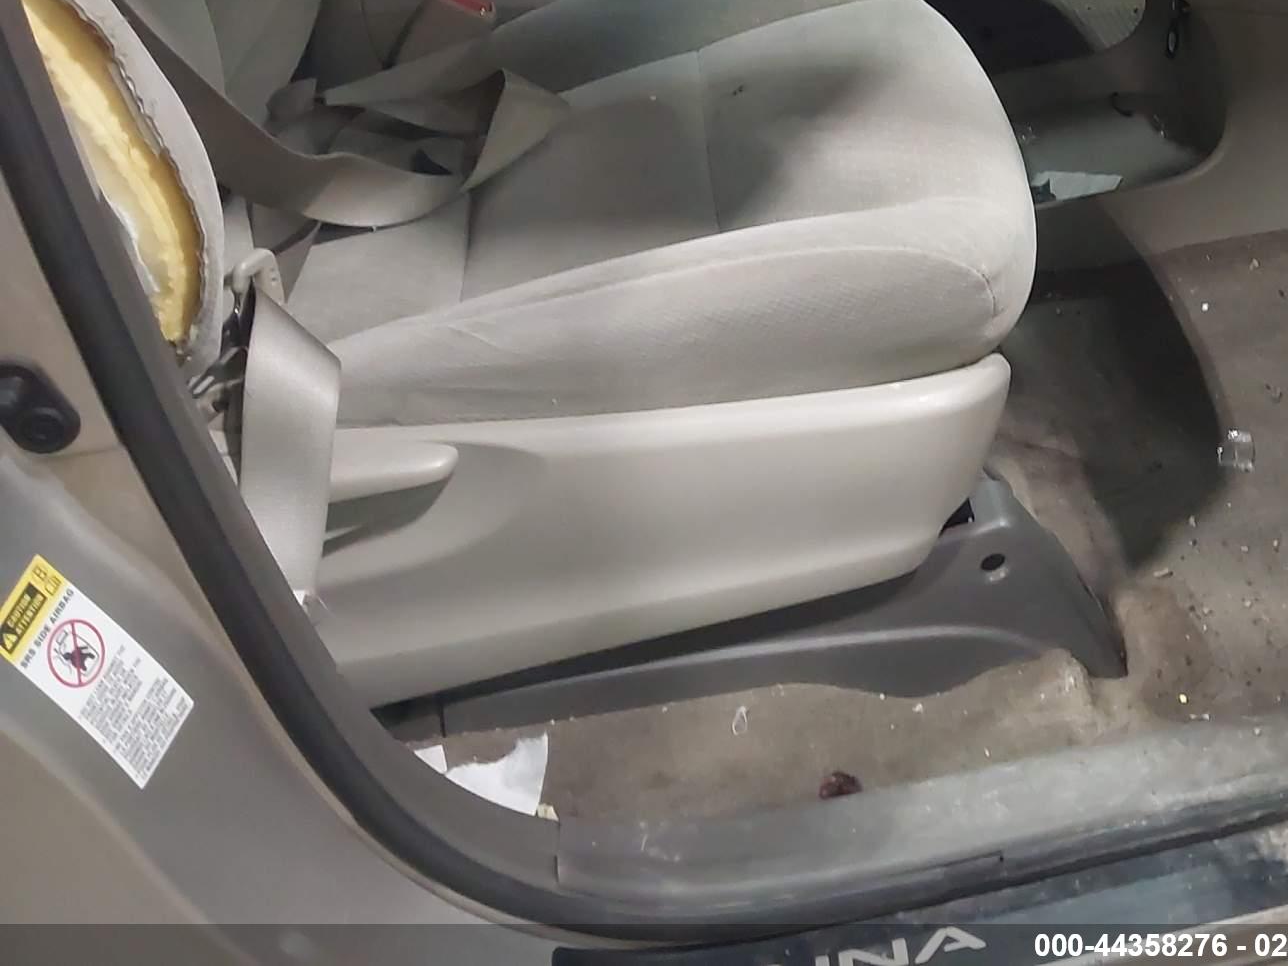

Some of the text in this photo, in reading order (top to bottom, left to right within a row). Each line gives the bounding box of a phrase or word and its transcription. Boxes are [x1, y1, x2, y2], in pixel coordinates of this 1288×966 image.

[7, 593, 31, 628] CAUTION
[15, 593, 44, 635] ATTENTION
[20, 588, 74, 669] SRS SIDE AIRBAG
